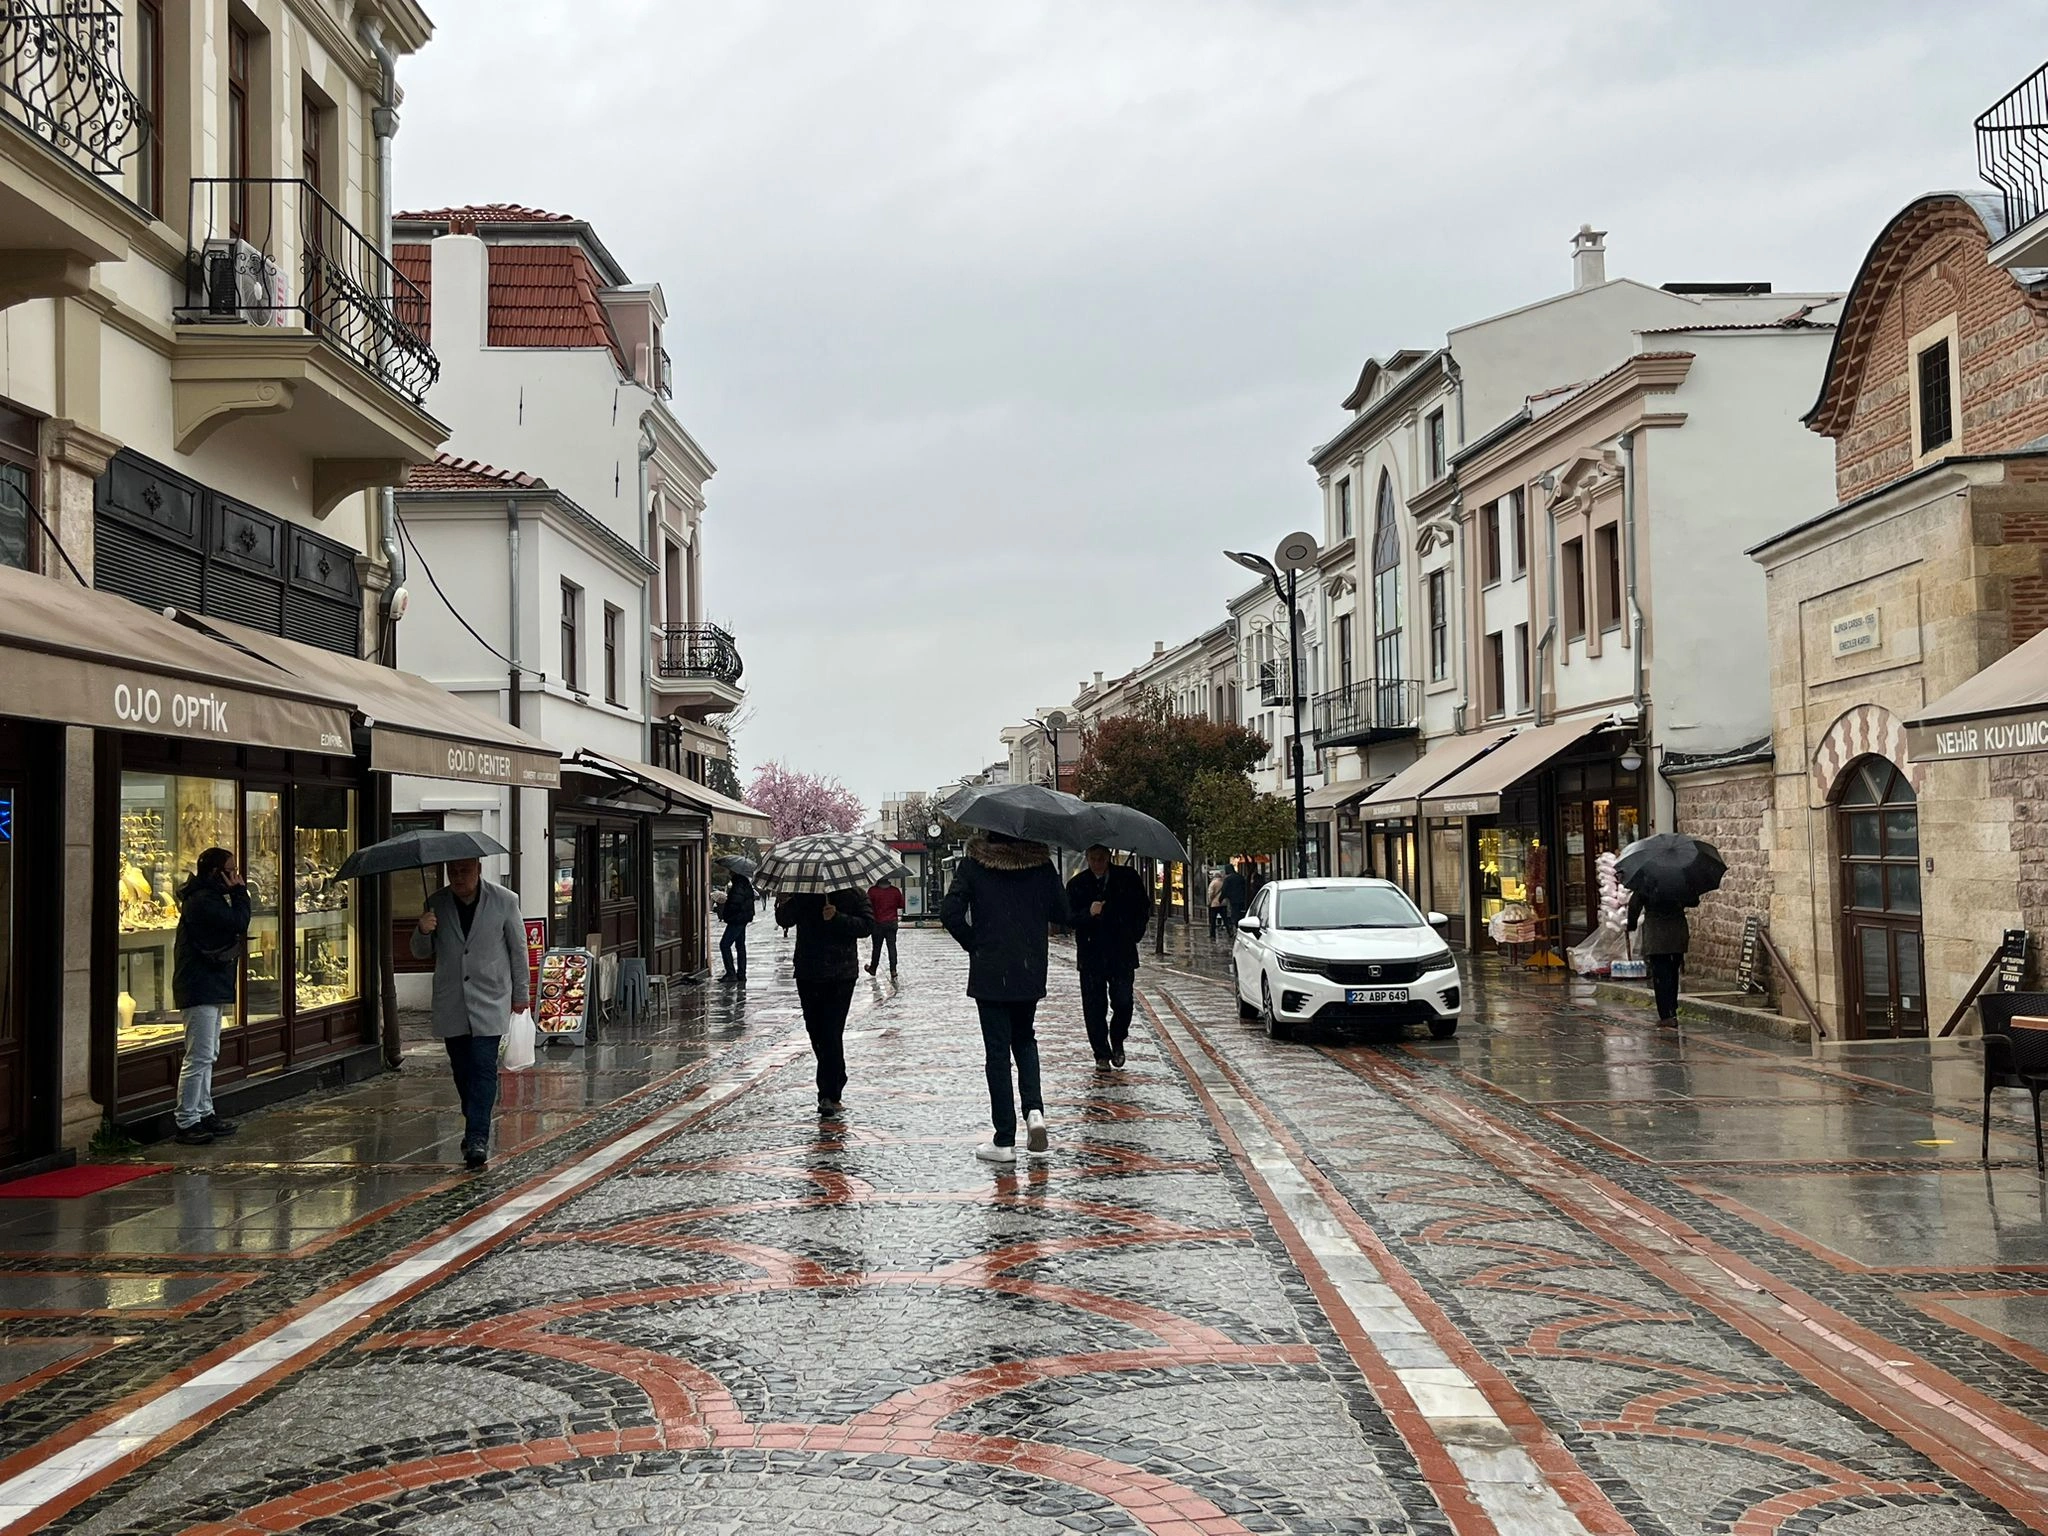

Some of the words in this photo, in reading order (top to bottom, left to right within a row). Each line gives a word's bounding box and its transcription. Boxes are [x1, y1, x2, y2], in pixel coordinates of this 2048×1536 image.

[115, 684, 161, 724] OJO
[172, 692, 229, 733] OPTİK
[1936, 725, 1978, 755] NEHİR
[1984, 720, 2048, 750] KUYUMC
[448, 748, 475, 772] GOLD
[478, 753, 511, 777] CENTER
[2002, 973, 2020, 983] EKRAN
[1352, 992, 1365, 1002] 22
[1369, 992, 1387, 1002] ABP
[1388, 991, 1406, 1001] 649
